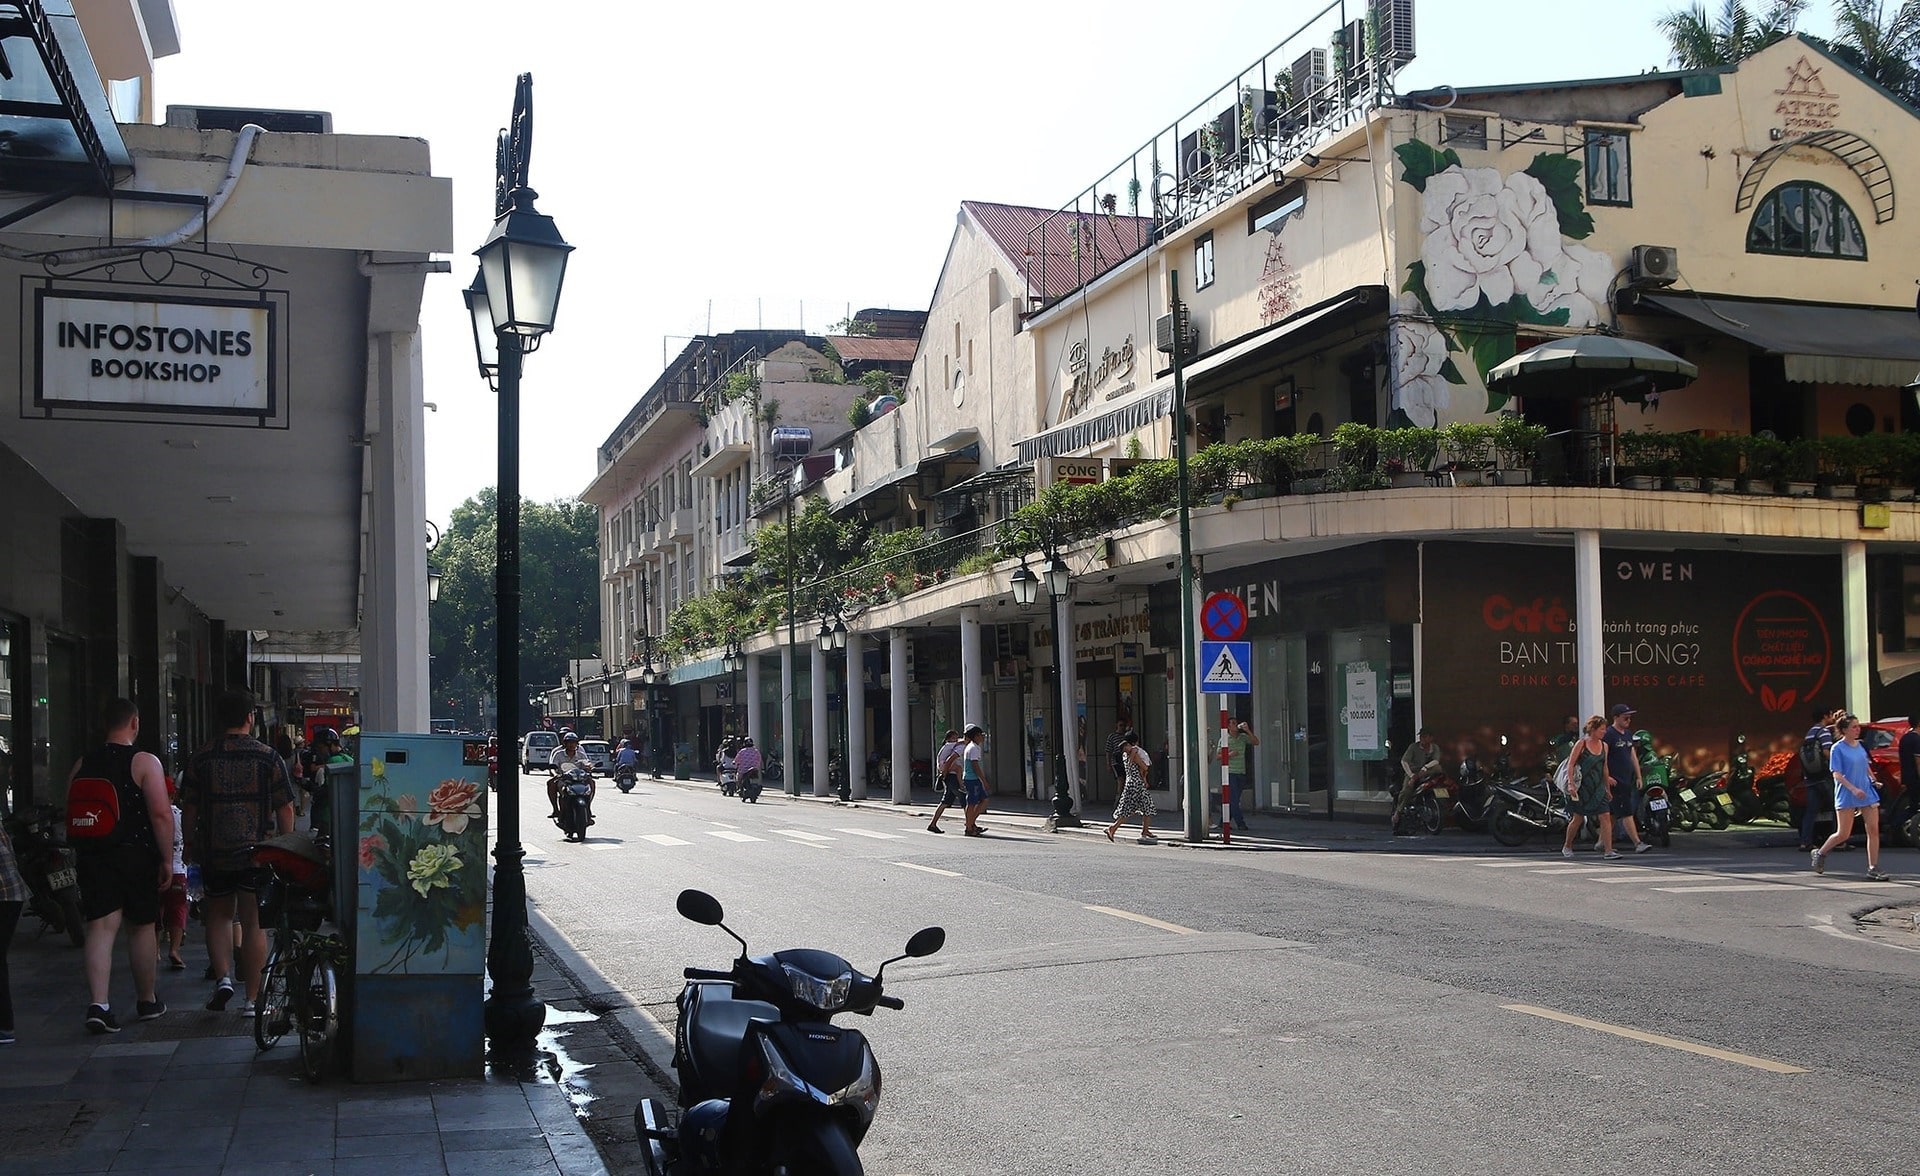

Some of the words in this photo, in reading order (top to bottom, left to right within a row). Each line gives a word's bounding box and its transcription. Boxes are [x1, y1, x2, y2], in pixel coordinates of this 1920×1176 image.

[1776, 101, 1840, 117] ATTIC
[58, 321, 252, 357] INFOSTONES
[91, 358, 222, 383] BOOKSHOP
[1617, 561, 1693, 581] OWEN
[1206, 581, 1279, 618] EN
[1482, 594, 1568, 633] Café
[1602, 620, 1631, 633] hành
[1635, 621, 1667, 636] trang
[1670, 622, 1699, 637] phục
[1500, 641, 1549, 668] BẠN
[1556, 642, 1576, 664] TI
[1603, 638, 1700, 665] KHÔNG?
[1311, 661, 1321, 674] 46
[1501, 674, 1549, 686] DRINK
[1611, 675, 1659, 687] DRESS
[1349, 710, 1376, 719] 100.000đ
[72, 817, 94, 827] PUMA
[808, 1033, 836, 1041] HONDA
